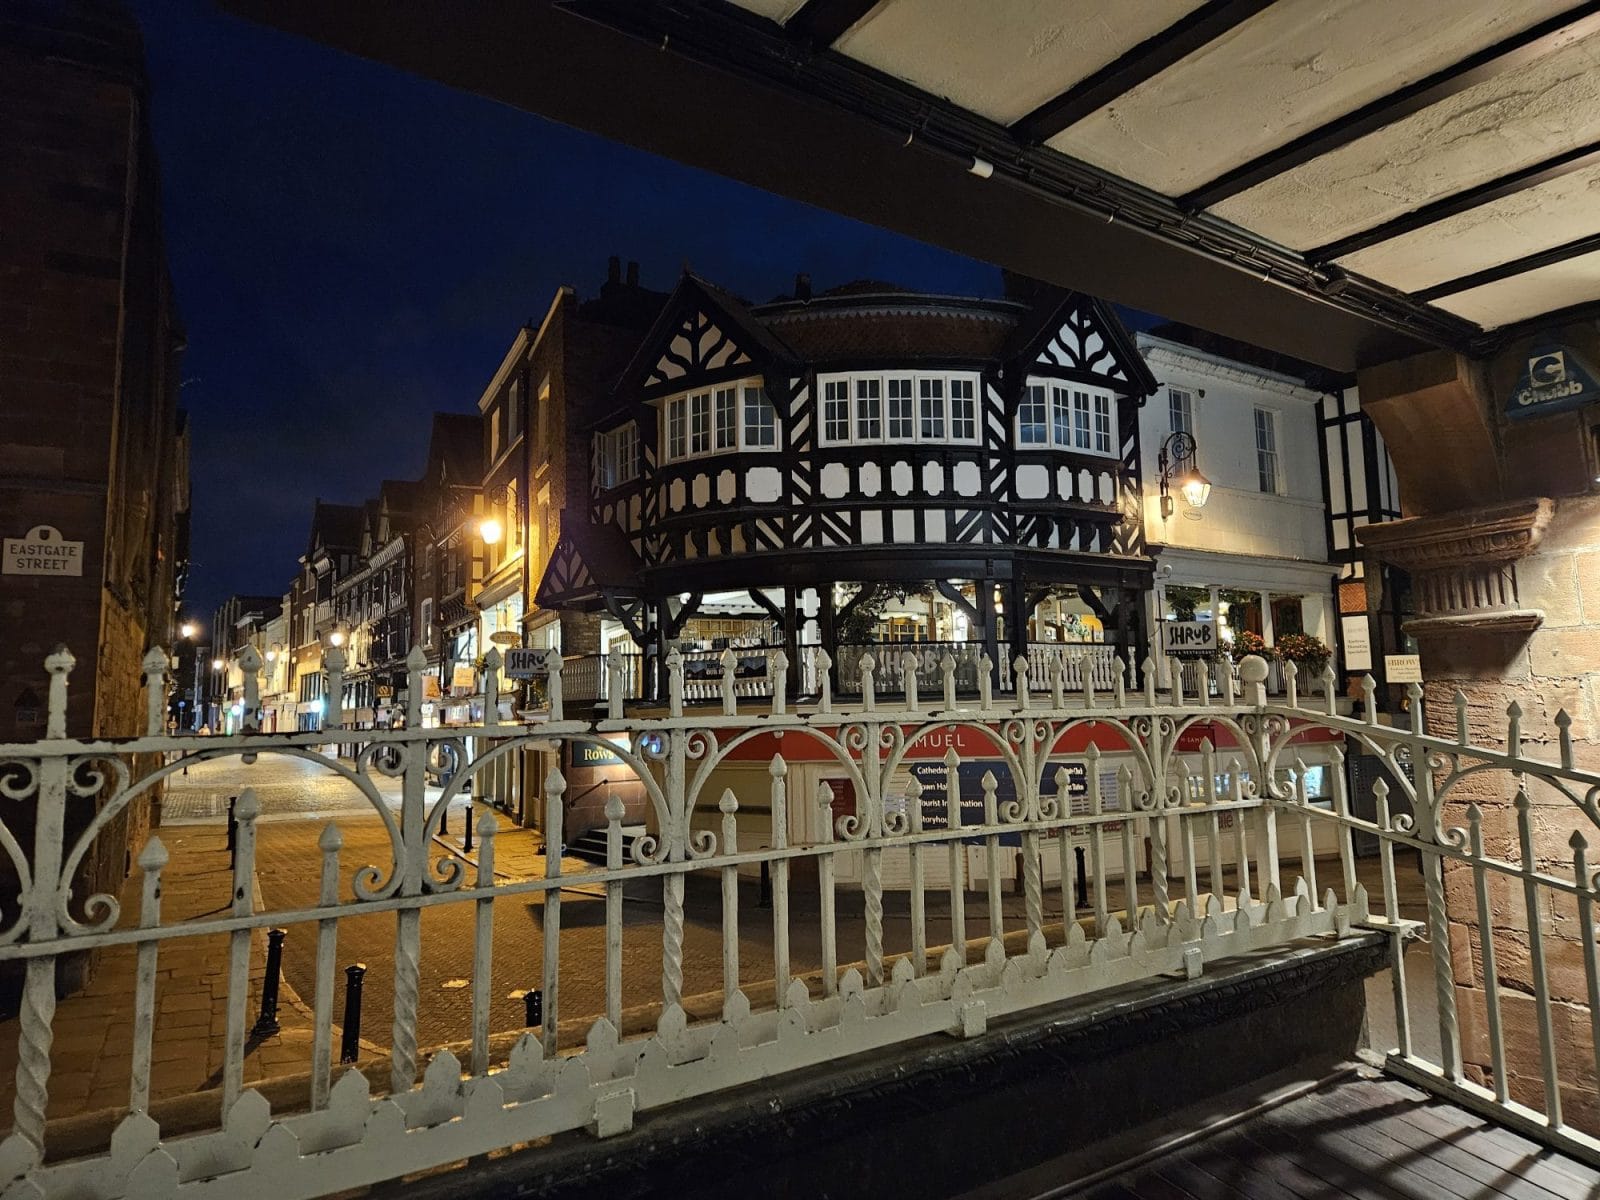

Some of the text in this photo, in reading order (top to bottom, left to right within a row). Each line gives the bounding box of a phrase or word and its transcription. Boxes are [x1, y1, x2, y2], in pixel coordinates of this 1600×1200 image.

[1518, 381, 1583, 406] Cbb
[10, 543, 77, 556] EASTGATE
[16, 558, 68, 569] STREET
[879, 650, 937, 675] SHB
[914, 734, 966, 748] MUEL
[917, 767, 950, 775] Cathedral
[936, 783, 948, 791] Hal
[920, 800, 983, 808] ourist Inmation
[920, 815, 948, 825] toryhou
